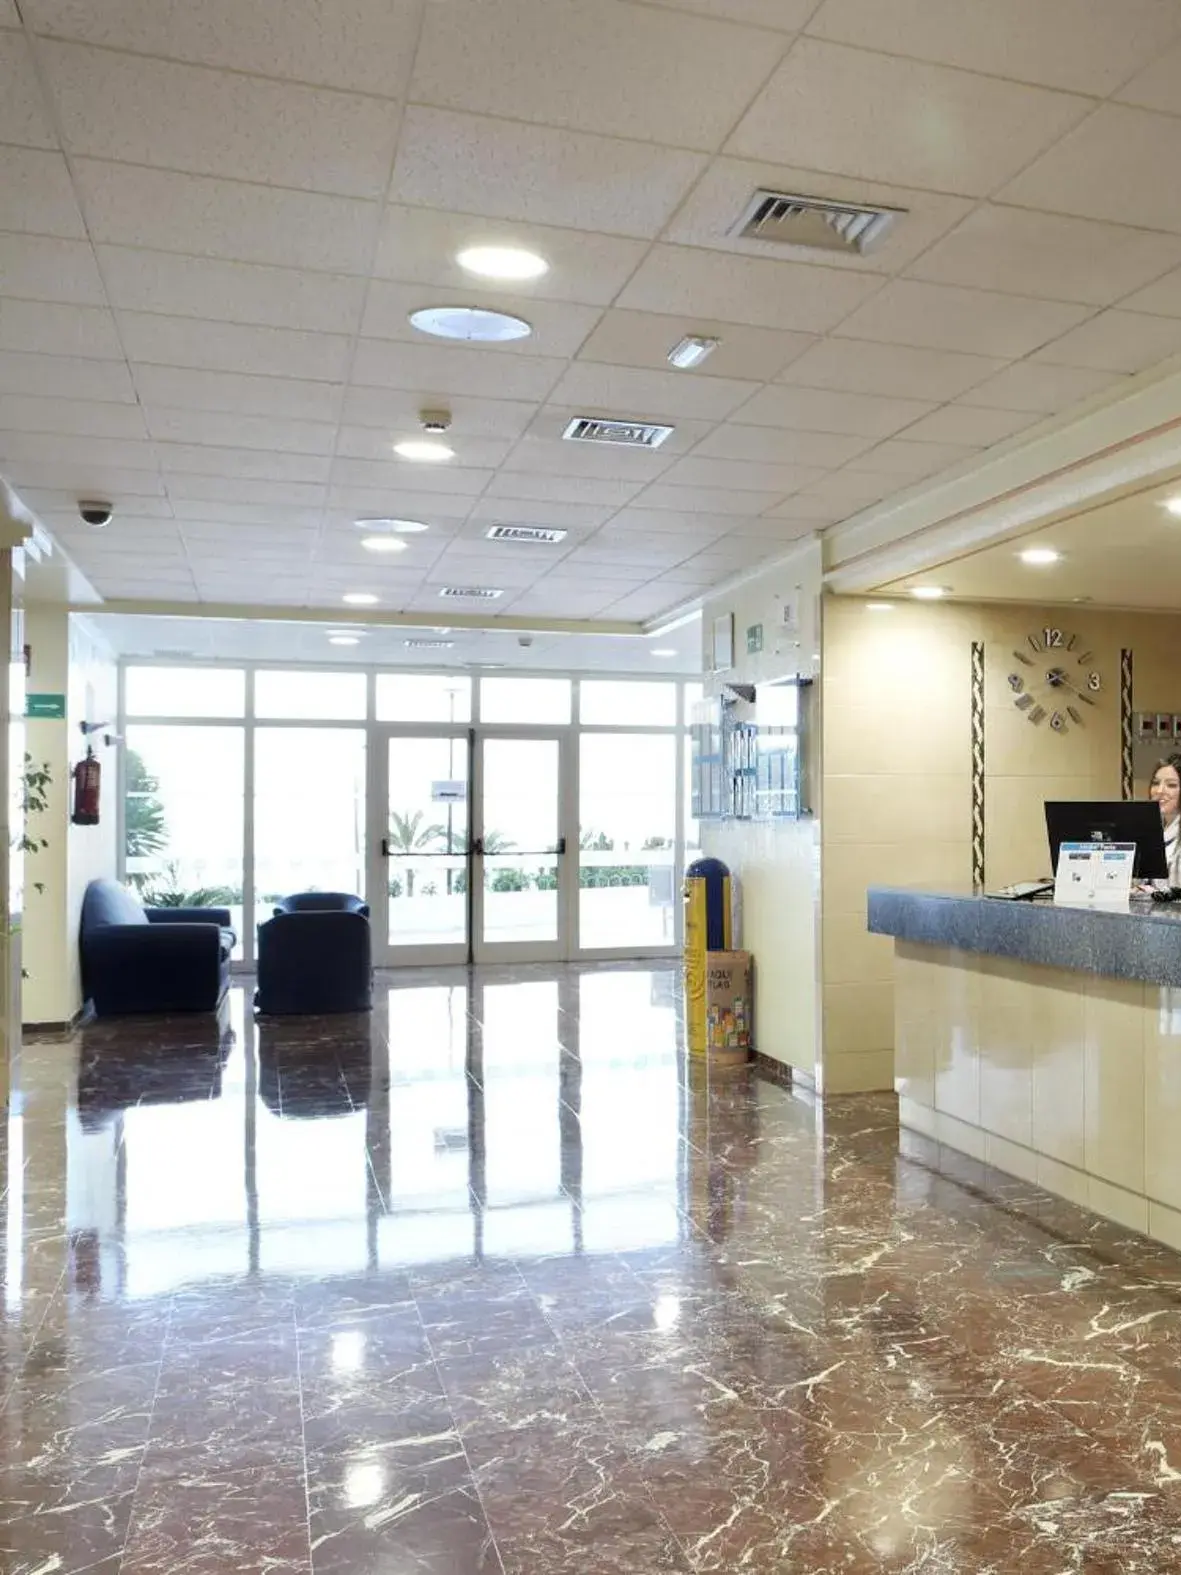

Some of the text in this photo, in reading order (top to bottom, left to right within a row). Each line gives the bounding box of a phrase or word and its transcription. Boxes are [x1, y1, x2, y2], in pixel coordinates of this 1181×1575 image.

[1044, 628, 1063, 648] 12
[1088, 672, 1100, 691] 3
[1050, 712, 1065, 732] 6
